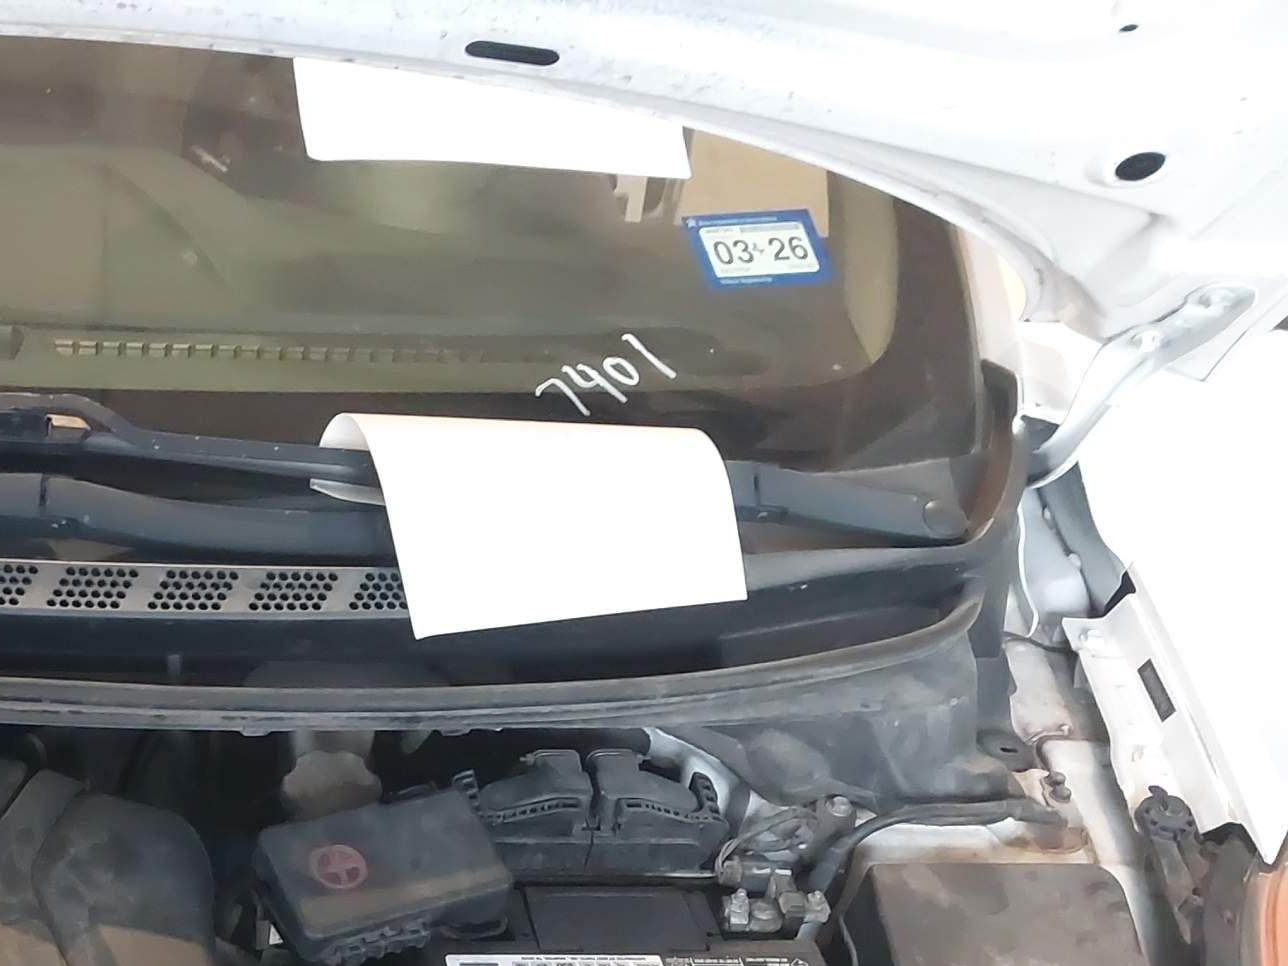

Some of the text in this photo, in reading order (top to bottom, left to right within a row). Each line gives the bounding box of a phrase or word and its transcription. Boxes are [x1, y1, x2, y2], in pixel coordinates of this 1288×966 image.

[713, 236, 809, 265] 03 26
[535, 333, 677, 416] 7401
